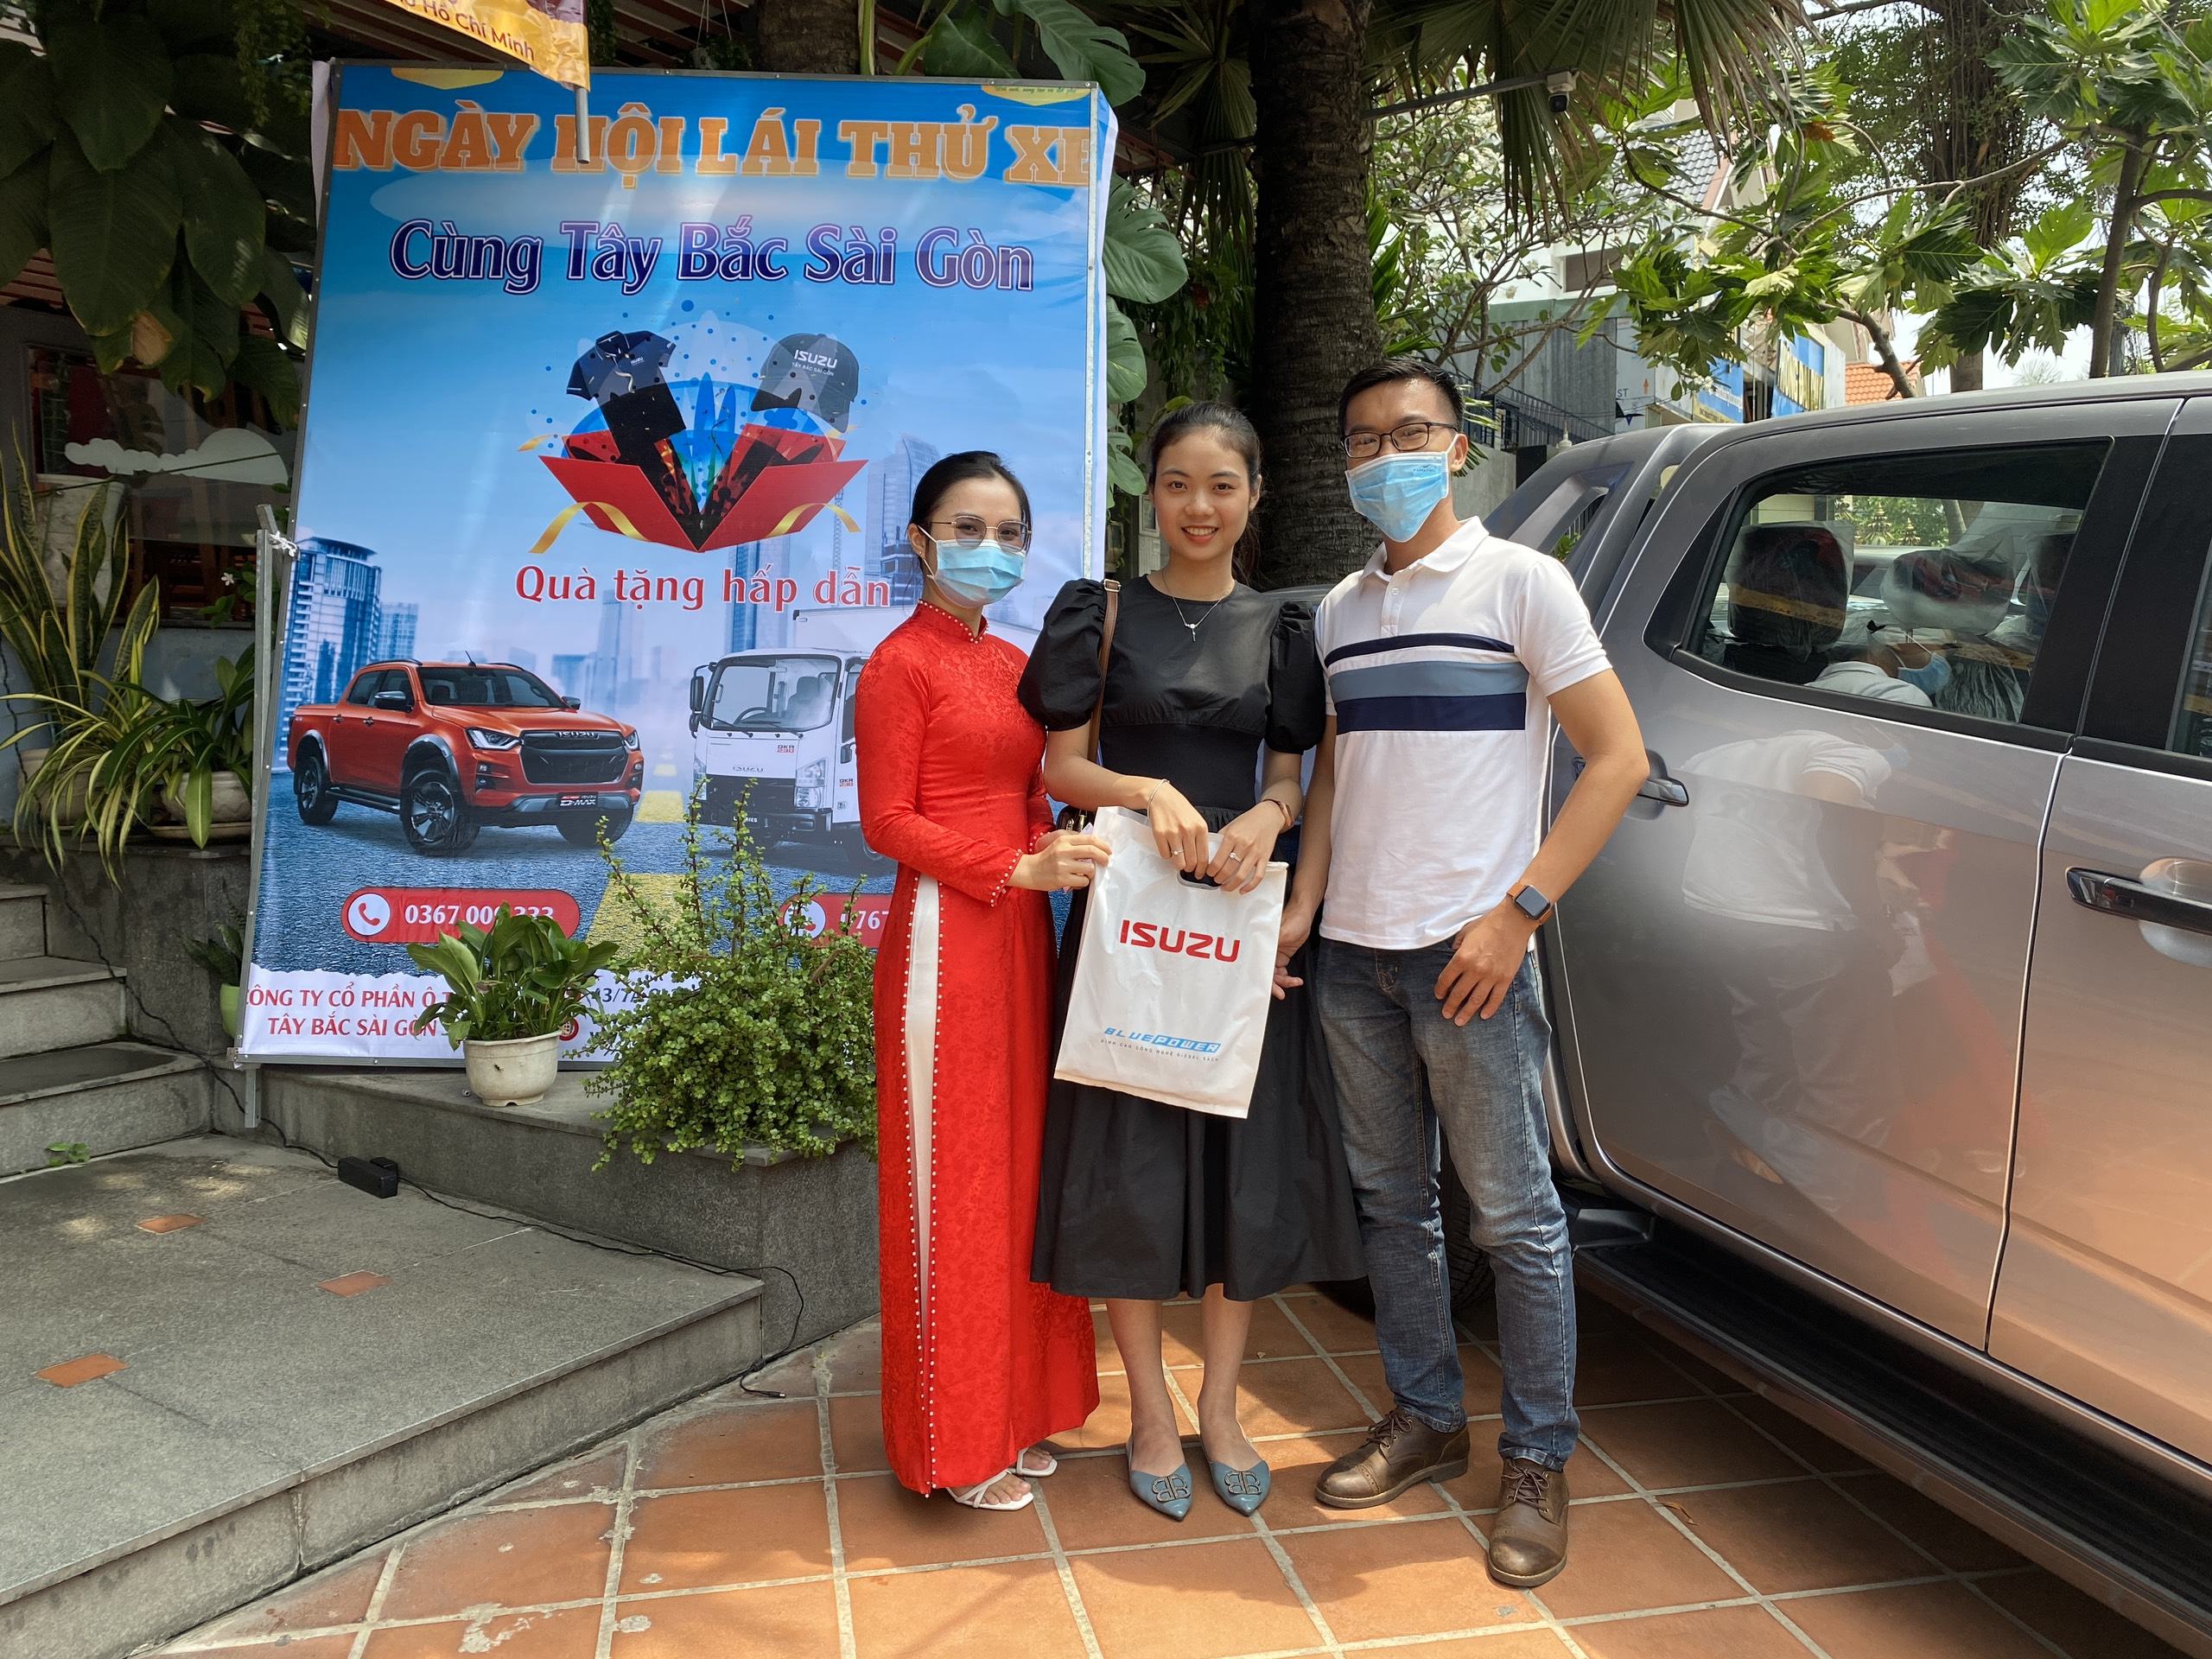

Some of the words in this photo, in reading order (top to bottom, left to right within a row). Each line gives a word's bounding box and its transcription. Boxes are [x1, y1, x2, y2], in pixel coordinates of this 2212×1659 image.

[454, 13, 486, 38] Chí
[491, 28, 536, 61] Minh
[333, 100, 540, 171] NGÀY
[551, 102, 685, 189] HỘI
[695, 107, 823, 178] LÁI
[836, 103, 999, 180] THỬ
[1002, 124, 1090, 187] XE
[389, 218, 543, 295] Cùng
[560, 220, 664, 296] Tây
[677, 213, 789, 283] Bắc
[803, 223, 898, 286] Sài
[915, 226, 1035, 292] Gòn
[794, 349, 837, 368] ISUZU
[516, 564, 596, 604] Quà
[613, 568, 704, 611] tặng
[722, 563, 798, 613] hấp
[812, 566, 891, 607] dẫn
[404, 905, 461, 925] 0367
[466, 905, 500, 925] 00
[1120, 919, 1240, 963] ISUZU
[247, 984, 293, 1007] ÔNG
[300, 989, 323, 1007] TY
[328, 982, 355, 1007] CỔ
[361, 983, 415, 1008] PHẦN
[422, 986, 436, 1008] Ô
[268, 1013, 306, 1035] TÂY
[311, 1011, 351, 1035] BẮC
[356, 1014, 388, 1036] SÀI
[394, 1014, 436, 1037] GÒN
